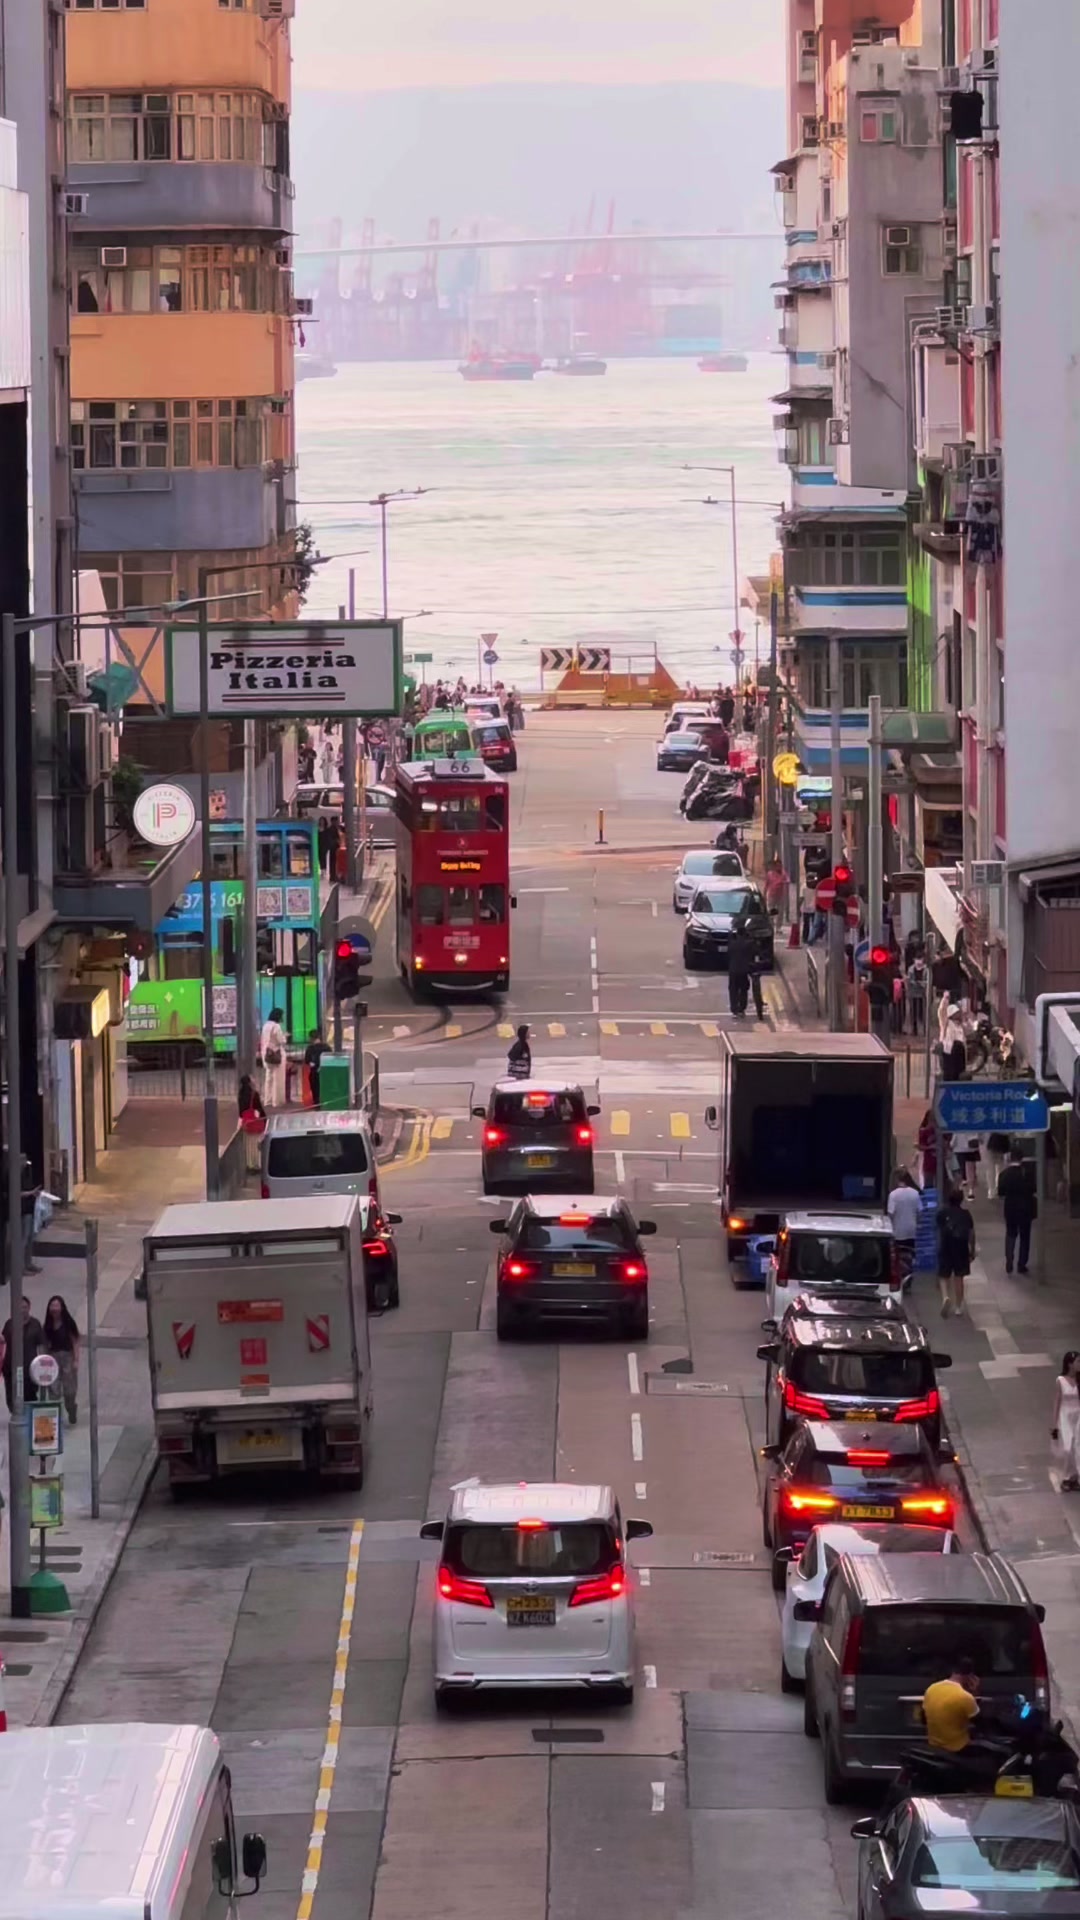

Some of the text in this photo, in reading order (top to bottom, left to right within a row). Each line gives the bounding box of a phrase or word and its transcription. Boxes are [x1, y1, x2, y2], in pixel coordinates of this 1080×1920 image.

[210, 651, 356, 669] Pizzeria
[228, 672, 338, 689] Italia
[450, 761, 471, 773] 66
[951, 1090, 1002, 1102] Victoria
